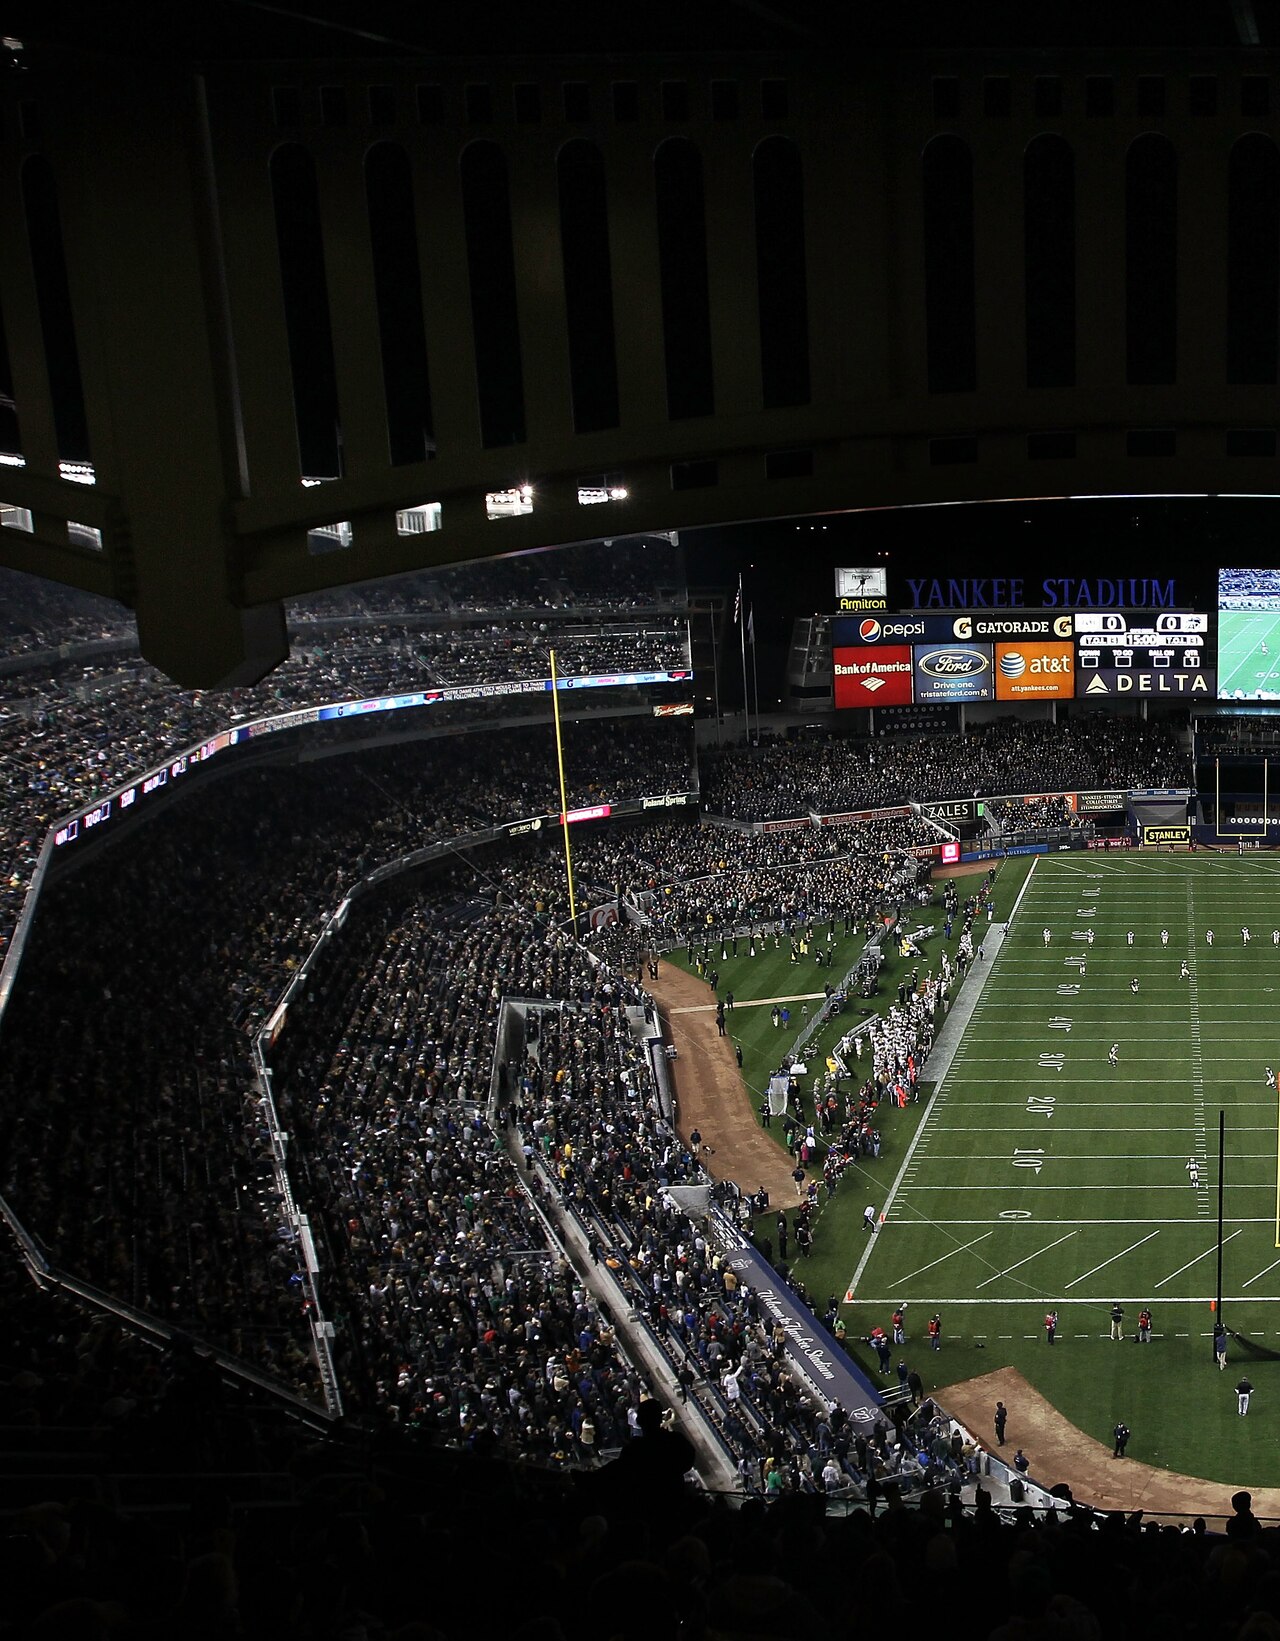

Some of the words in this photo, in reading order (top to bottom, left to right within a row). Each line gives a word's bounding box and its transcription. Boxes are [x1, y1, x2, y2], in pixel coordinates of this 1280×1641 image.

[906, 578, 1024, 609] YANKEE
[1042, 578, 1177, 608] STADIUM
[840, 598, 887, 611] Armitron
[883, 621, 925, 638] pepsi
[976, 621, 1049, 634] GATORADE
[1107, 617, 1117, 630] 0
[1167, 617, 1177, 630] 0
[834, 664, 860, 675] Bank
[860, 663, 871, 674] of
[871, 661, 911, 673] America
[935, 655, 973, 673] Ford
[1029, 655, 1071, 673] at&t
[1117, 674, 1208, 692] DELTA
[453, 692, 480, 700] FOLLOWING
[920, 690, 980, 698] tristateford.com
[643, 797, 665, 810] Poland
[665, 796, 687, 807] Spring
[929, 804, 969, 818] ZALES
[1149, 831, 1187, 840] STANLEY
[915, 848, 933, 857] Farm
[1056, 983, 1080, 996] 50
[1047, 1016, 1073, 1029] 40
[1036, 1052, 1065, 1068] 30
[1025, 1095, 1056, 1114] 20
[1011, 1147, 1045, 1168] 10
[757, 1289, 785, 1319] Welcome
[779, 1316, 793, 1325] to
[783, 1322, 814, 1351] Yankee
[804, 1349, 835, 1380] Stadium
